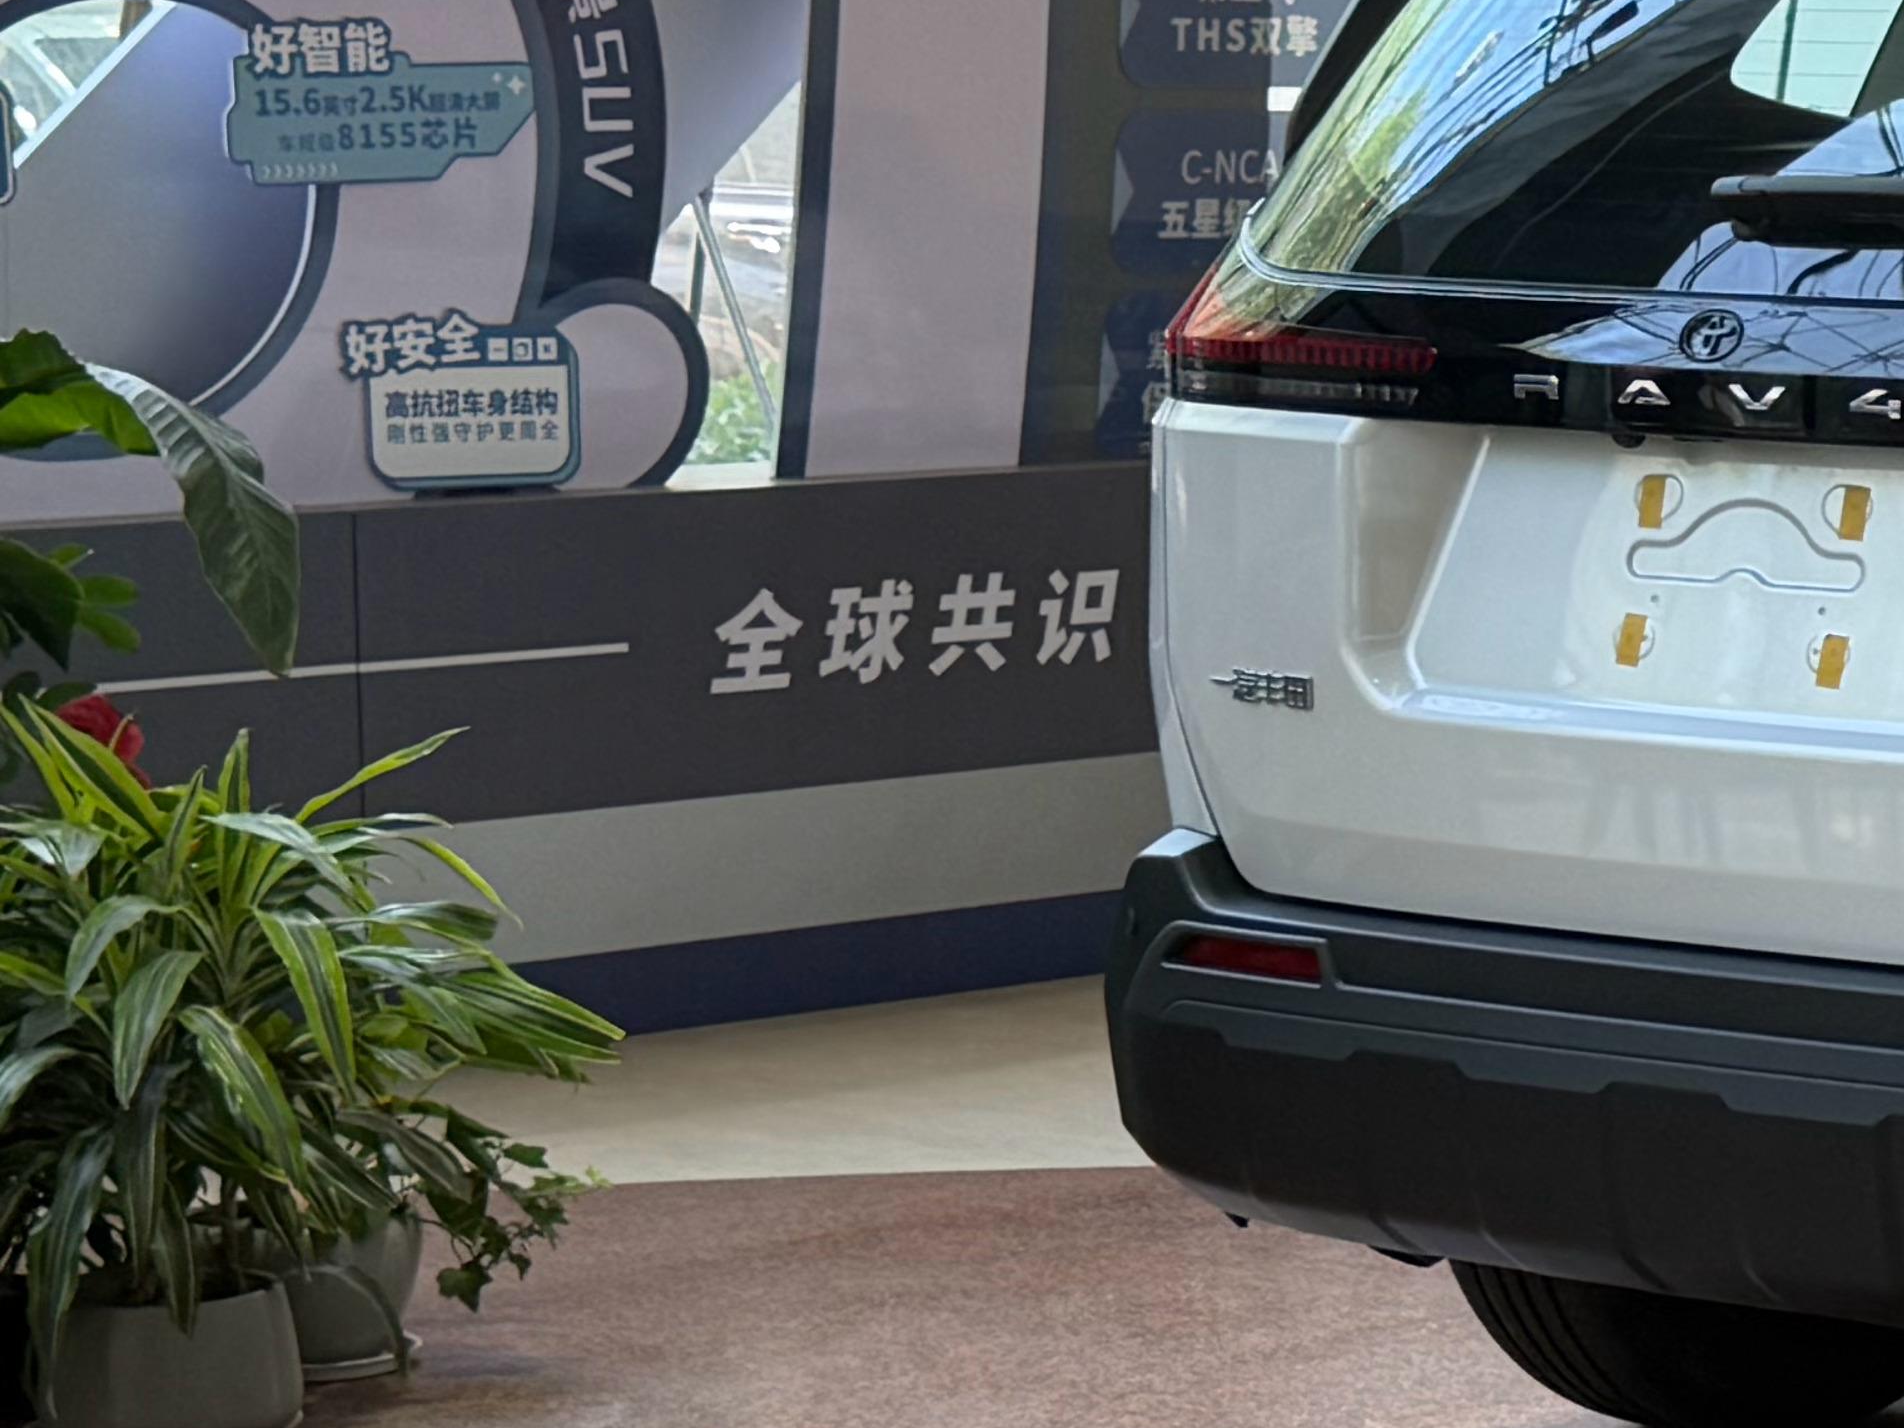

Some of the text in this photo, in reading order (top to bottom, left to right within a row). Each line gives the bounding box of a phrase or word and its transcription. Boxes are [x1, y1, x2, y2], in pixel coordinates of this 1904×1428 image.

[251, 21, 392, 76] 好智能
[1170, 15, 1319, 57] THS双擎
[1181, 149, 1281, 186] C-NCA
[344, 312, 482, 375] 好安全
[384, 387, 559, 419] 高抗扭车身结构
[1512, 373, 1902, 420] RAV4
[708, 568, 1120, 695] 全球共识
